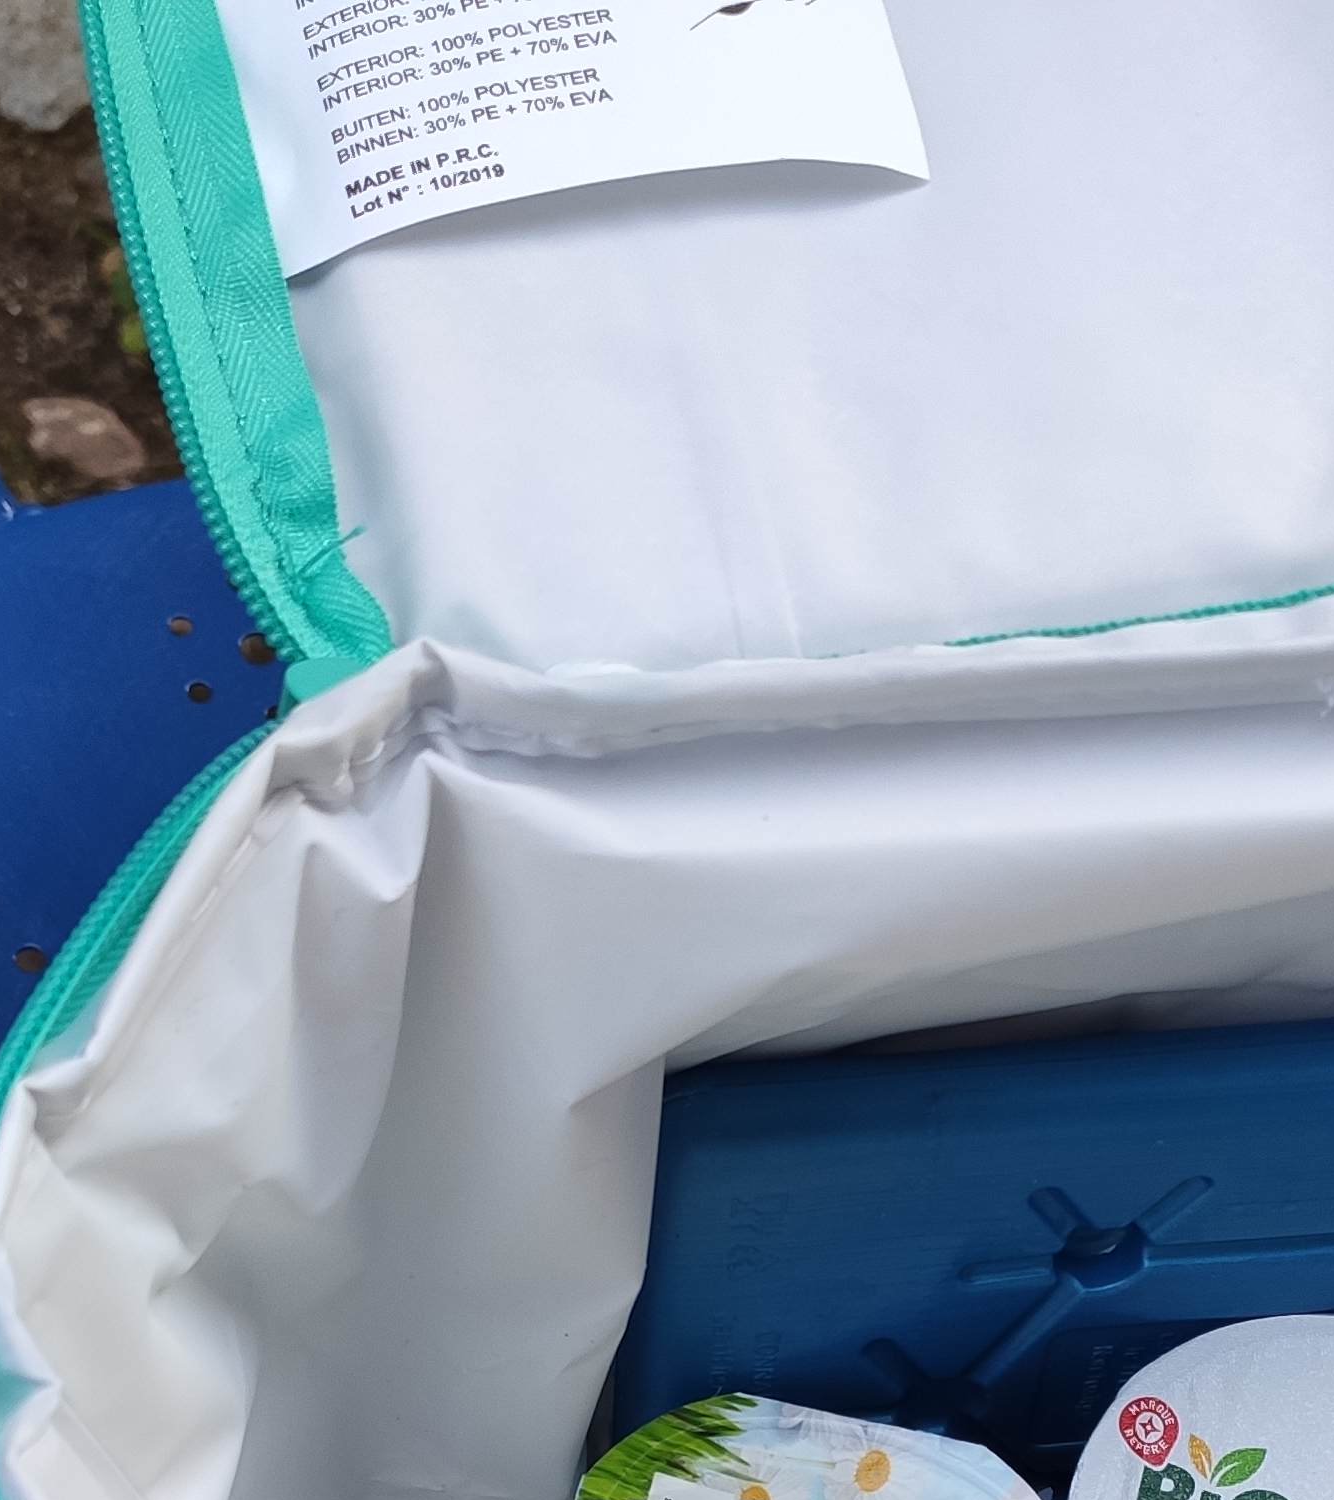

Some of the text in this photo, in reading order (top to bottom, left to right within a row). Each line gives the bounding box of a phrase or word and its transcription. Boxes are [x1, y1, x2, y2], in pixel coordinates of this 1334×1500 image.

[308, 15, 408, 60] INTERIOR:
[413, 2, 455, 23] 30%
[316, 9, 613, 92] EXTERIOR: 100% POLYESTER
[322, 30, 617, 112] INTERIOR: 30% PE + 70% EVA
[331, 68, 600, 145] BUITEN: 100% POLYESTER
[336, 88, 614, 165] BINNEN: 30% PE + 70% EVA
[345, 143, 499, 199] MADE IN P.R.C.
[350, 195, 383, 219] Lot
[429, 163, 505, 191] 10/2019
[1128, 1400, 1175, 1425] MARQUE
